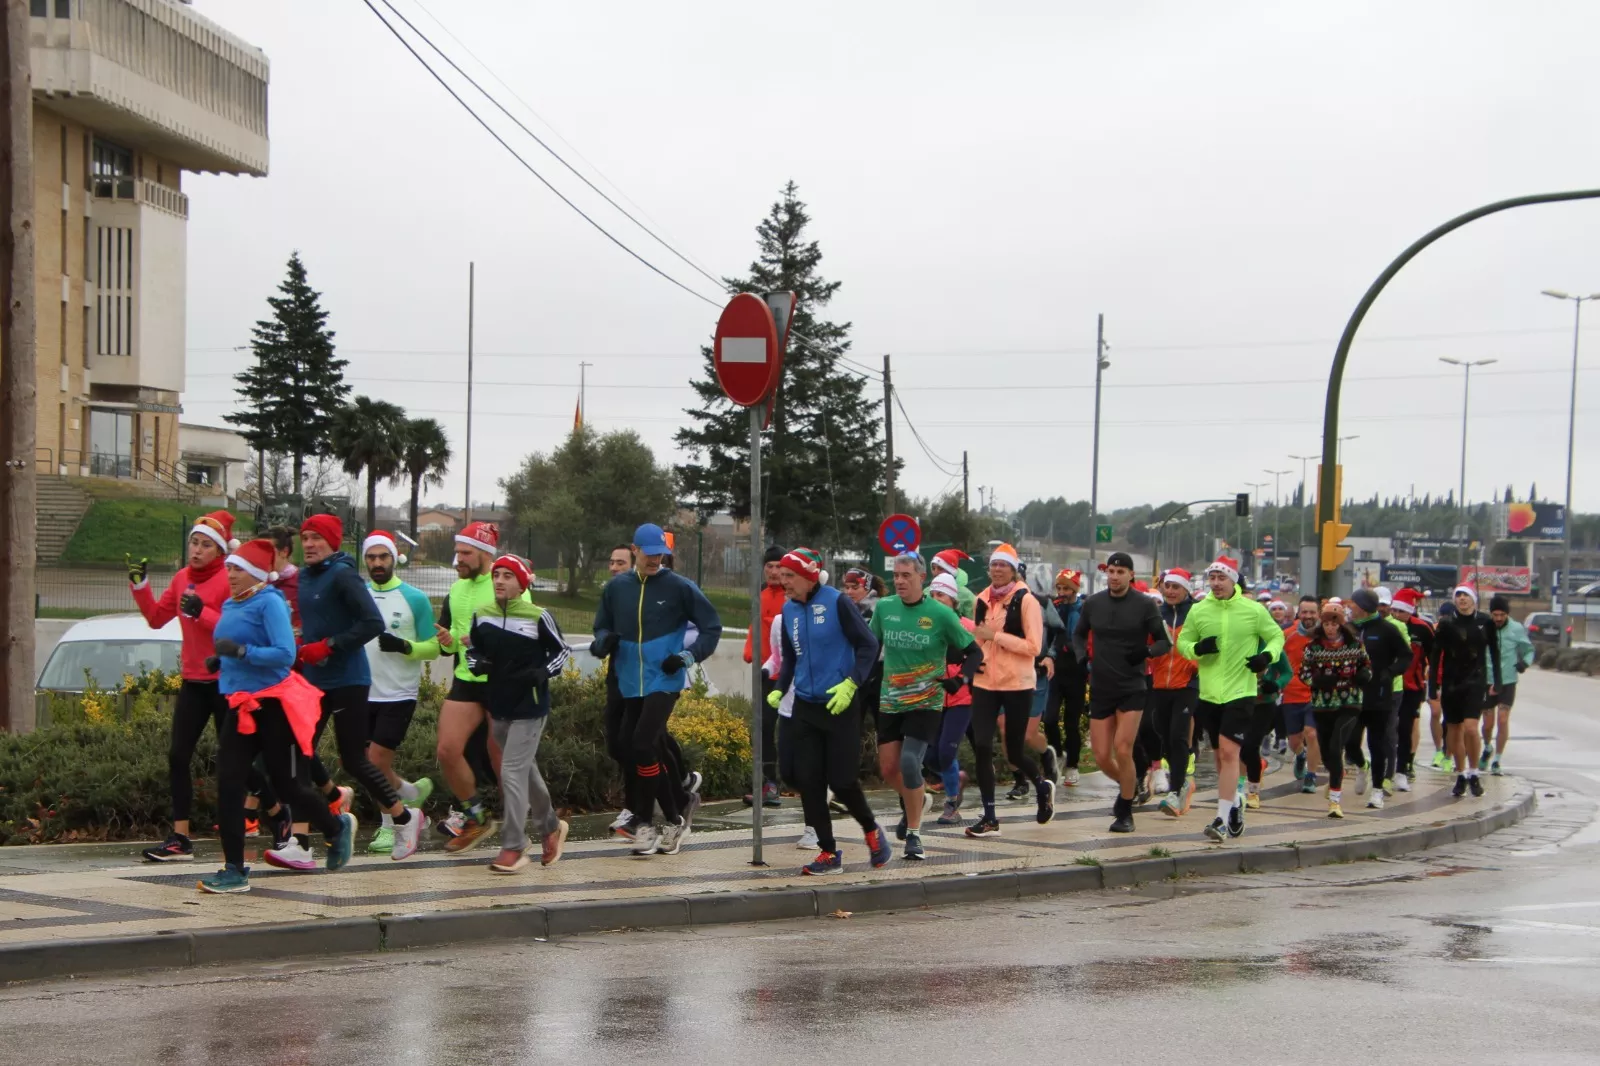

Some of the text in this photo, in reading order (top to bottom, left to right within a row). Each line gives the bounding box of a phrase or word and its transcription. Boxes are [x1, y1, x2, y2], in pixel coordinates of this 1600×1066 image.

[1542, 526, 1563, 535] repsol
[793, 617, 803, 656] Huesca
[884, 630, 930, 645] Huesca
